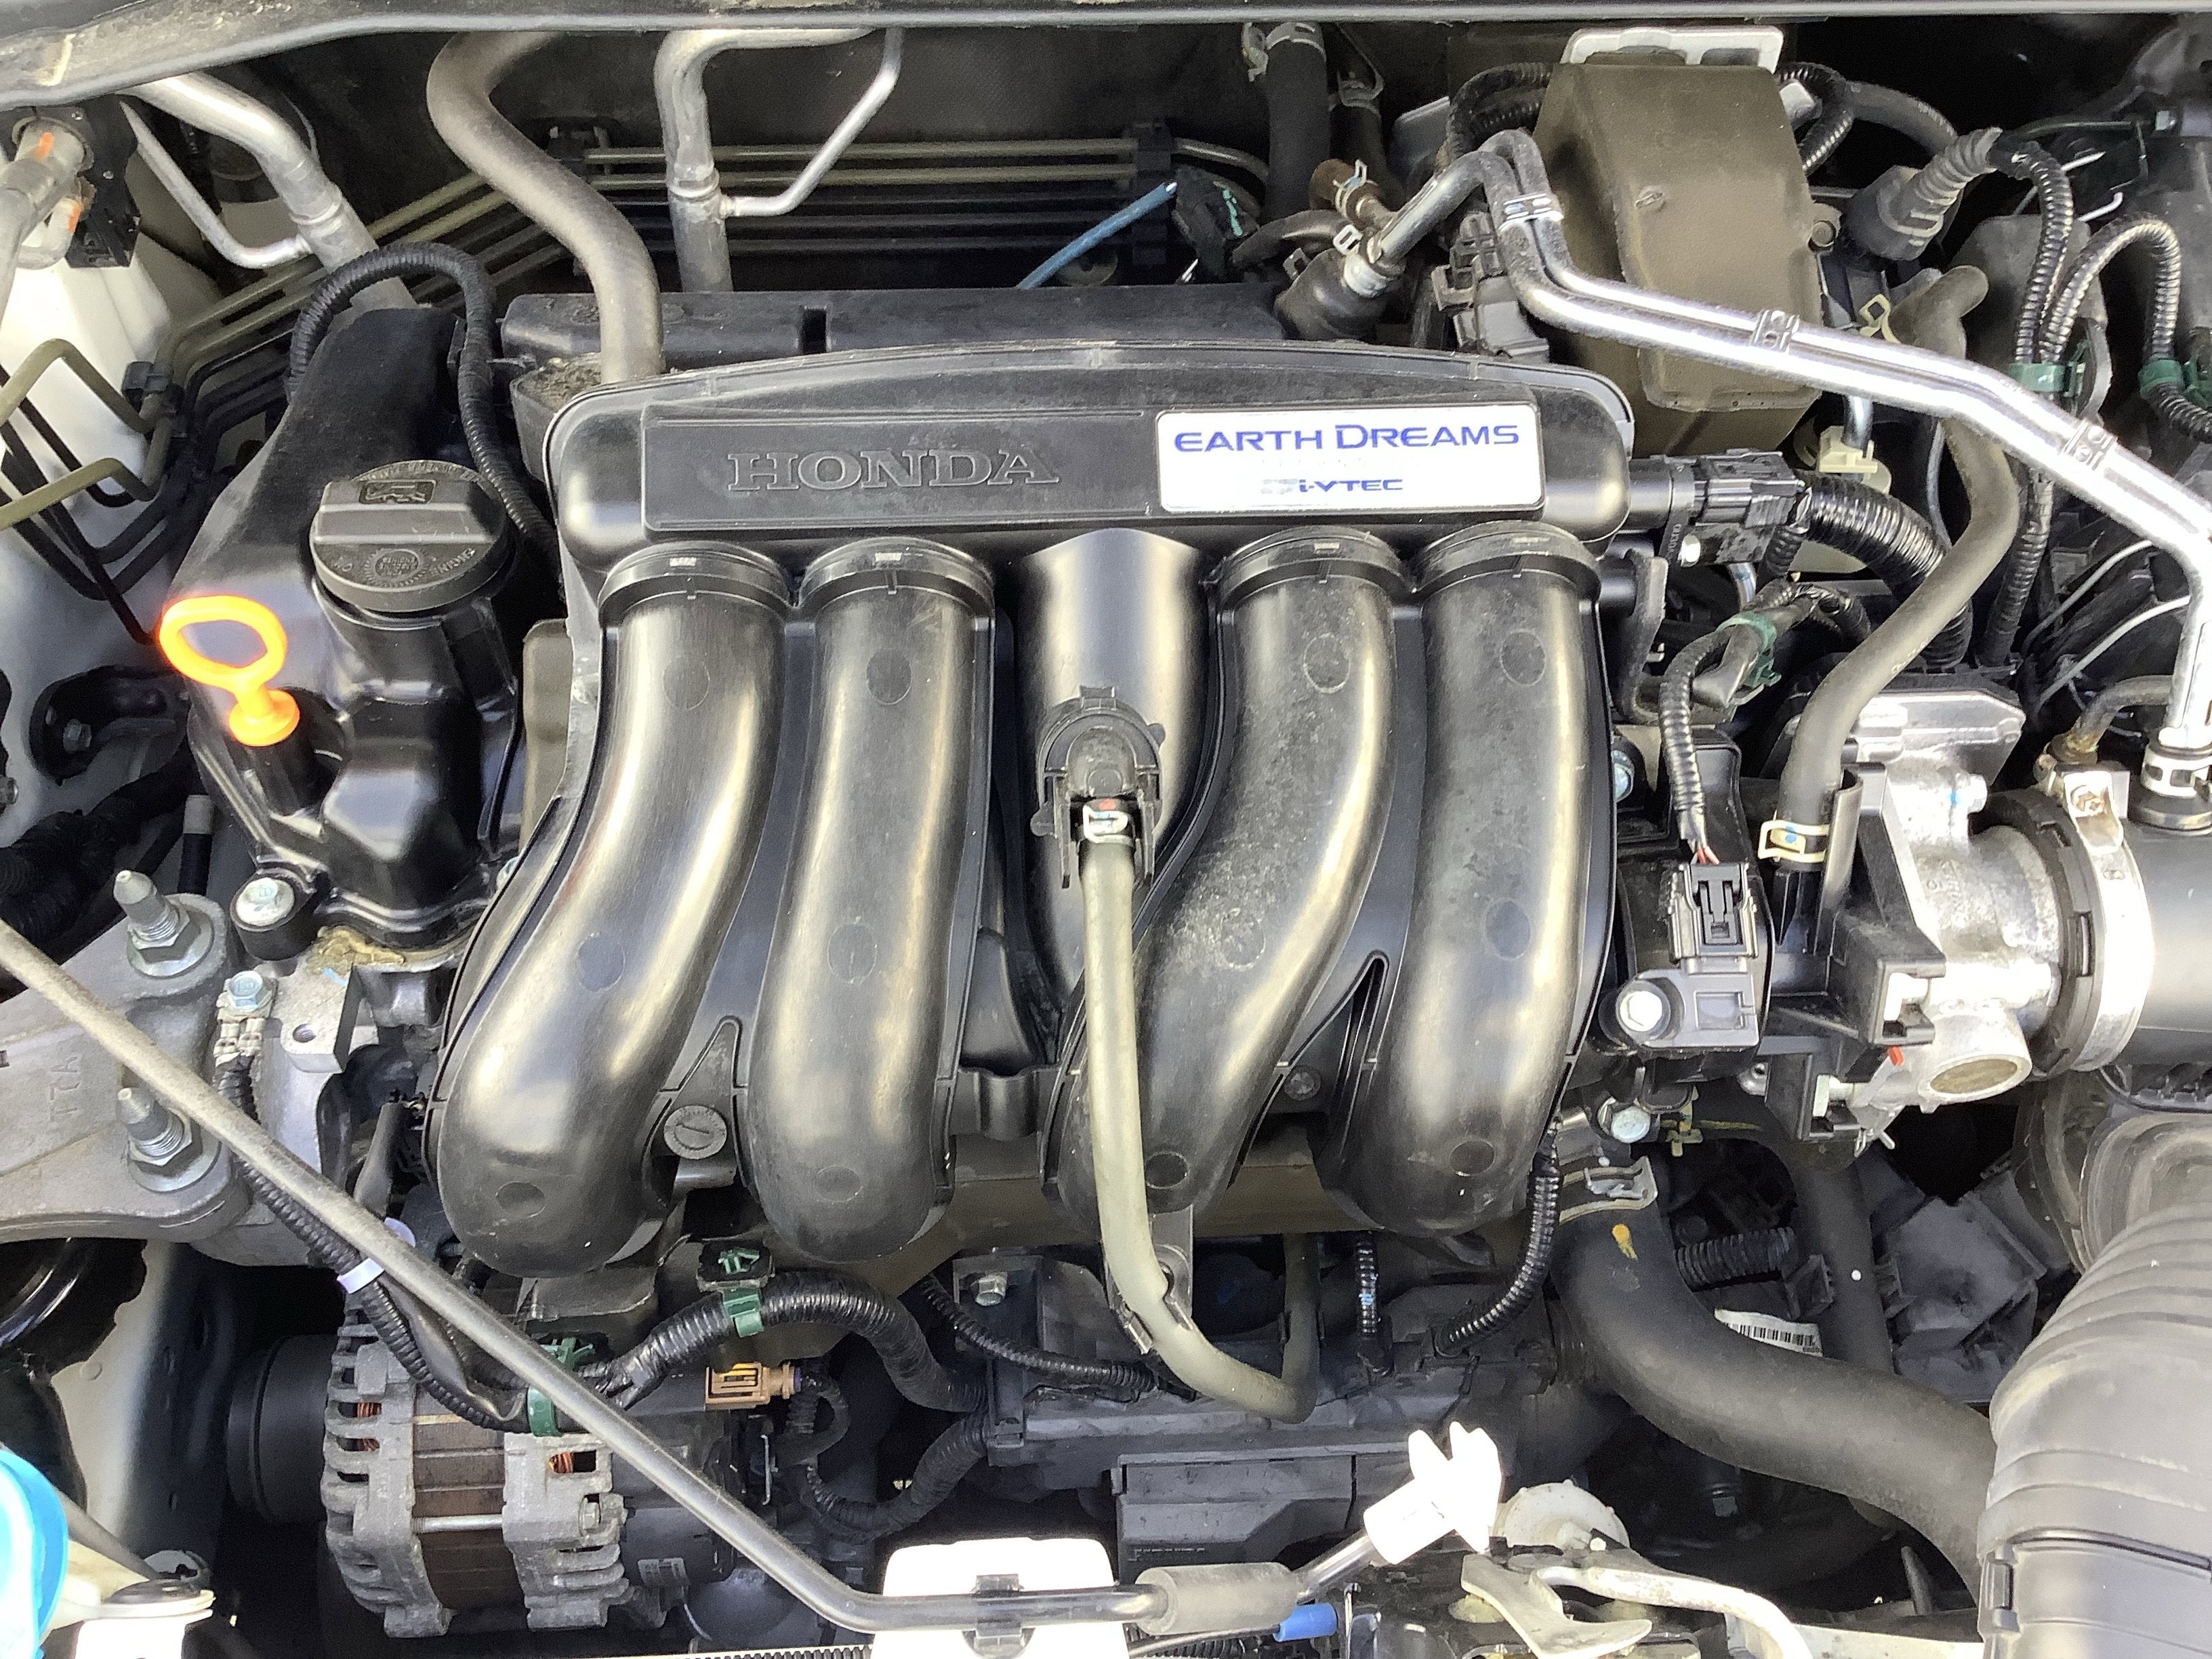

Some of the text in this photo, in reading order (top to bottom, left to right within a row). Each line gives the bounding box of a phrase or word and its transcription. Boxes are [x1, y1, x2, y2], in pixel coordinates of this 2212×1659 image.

[1174, 424, 1519, 453] EARTH DREAMS
[727, 449, 1060, 491] HONDA
